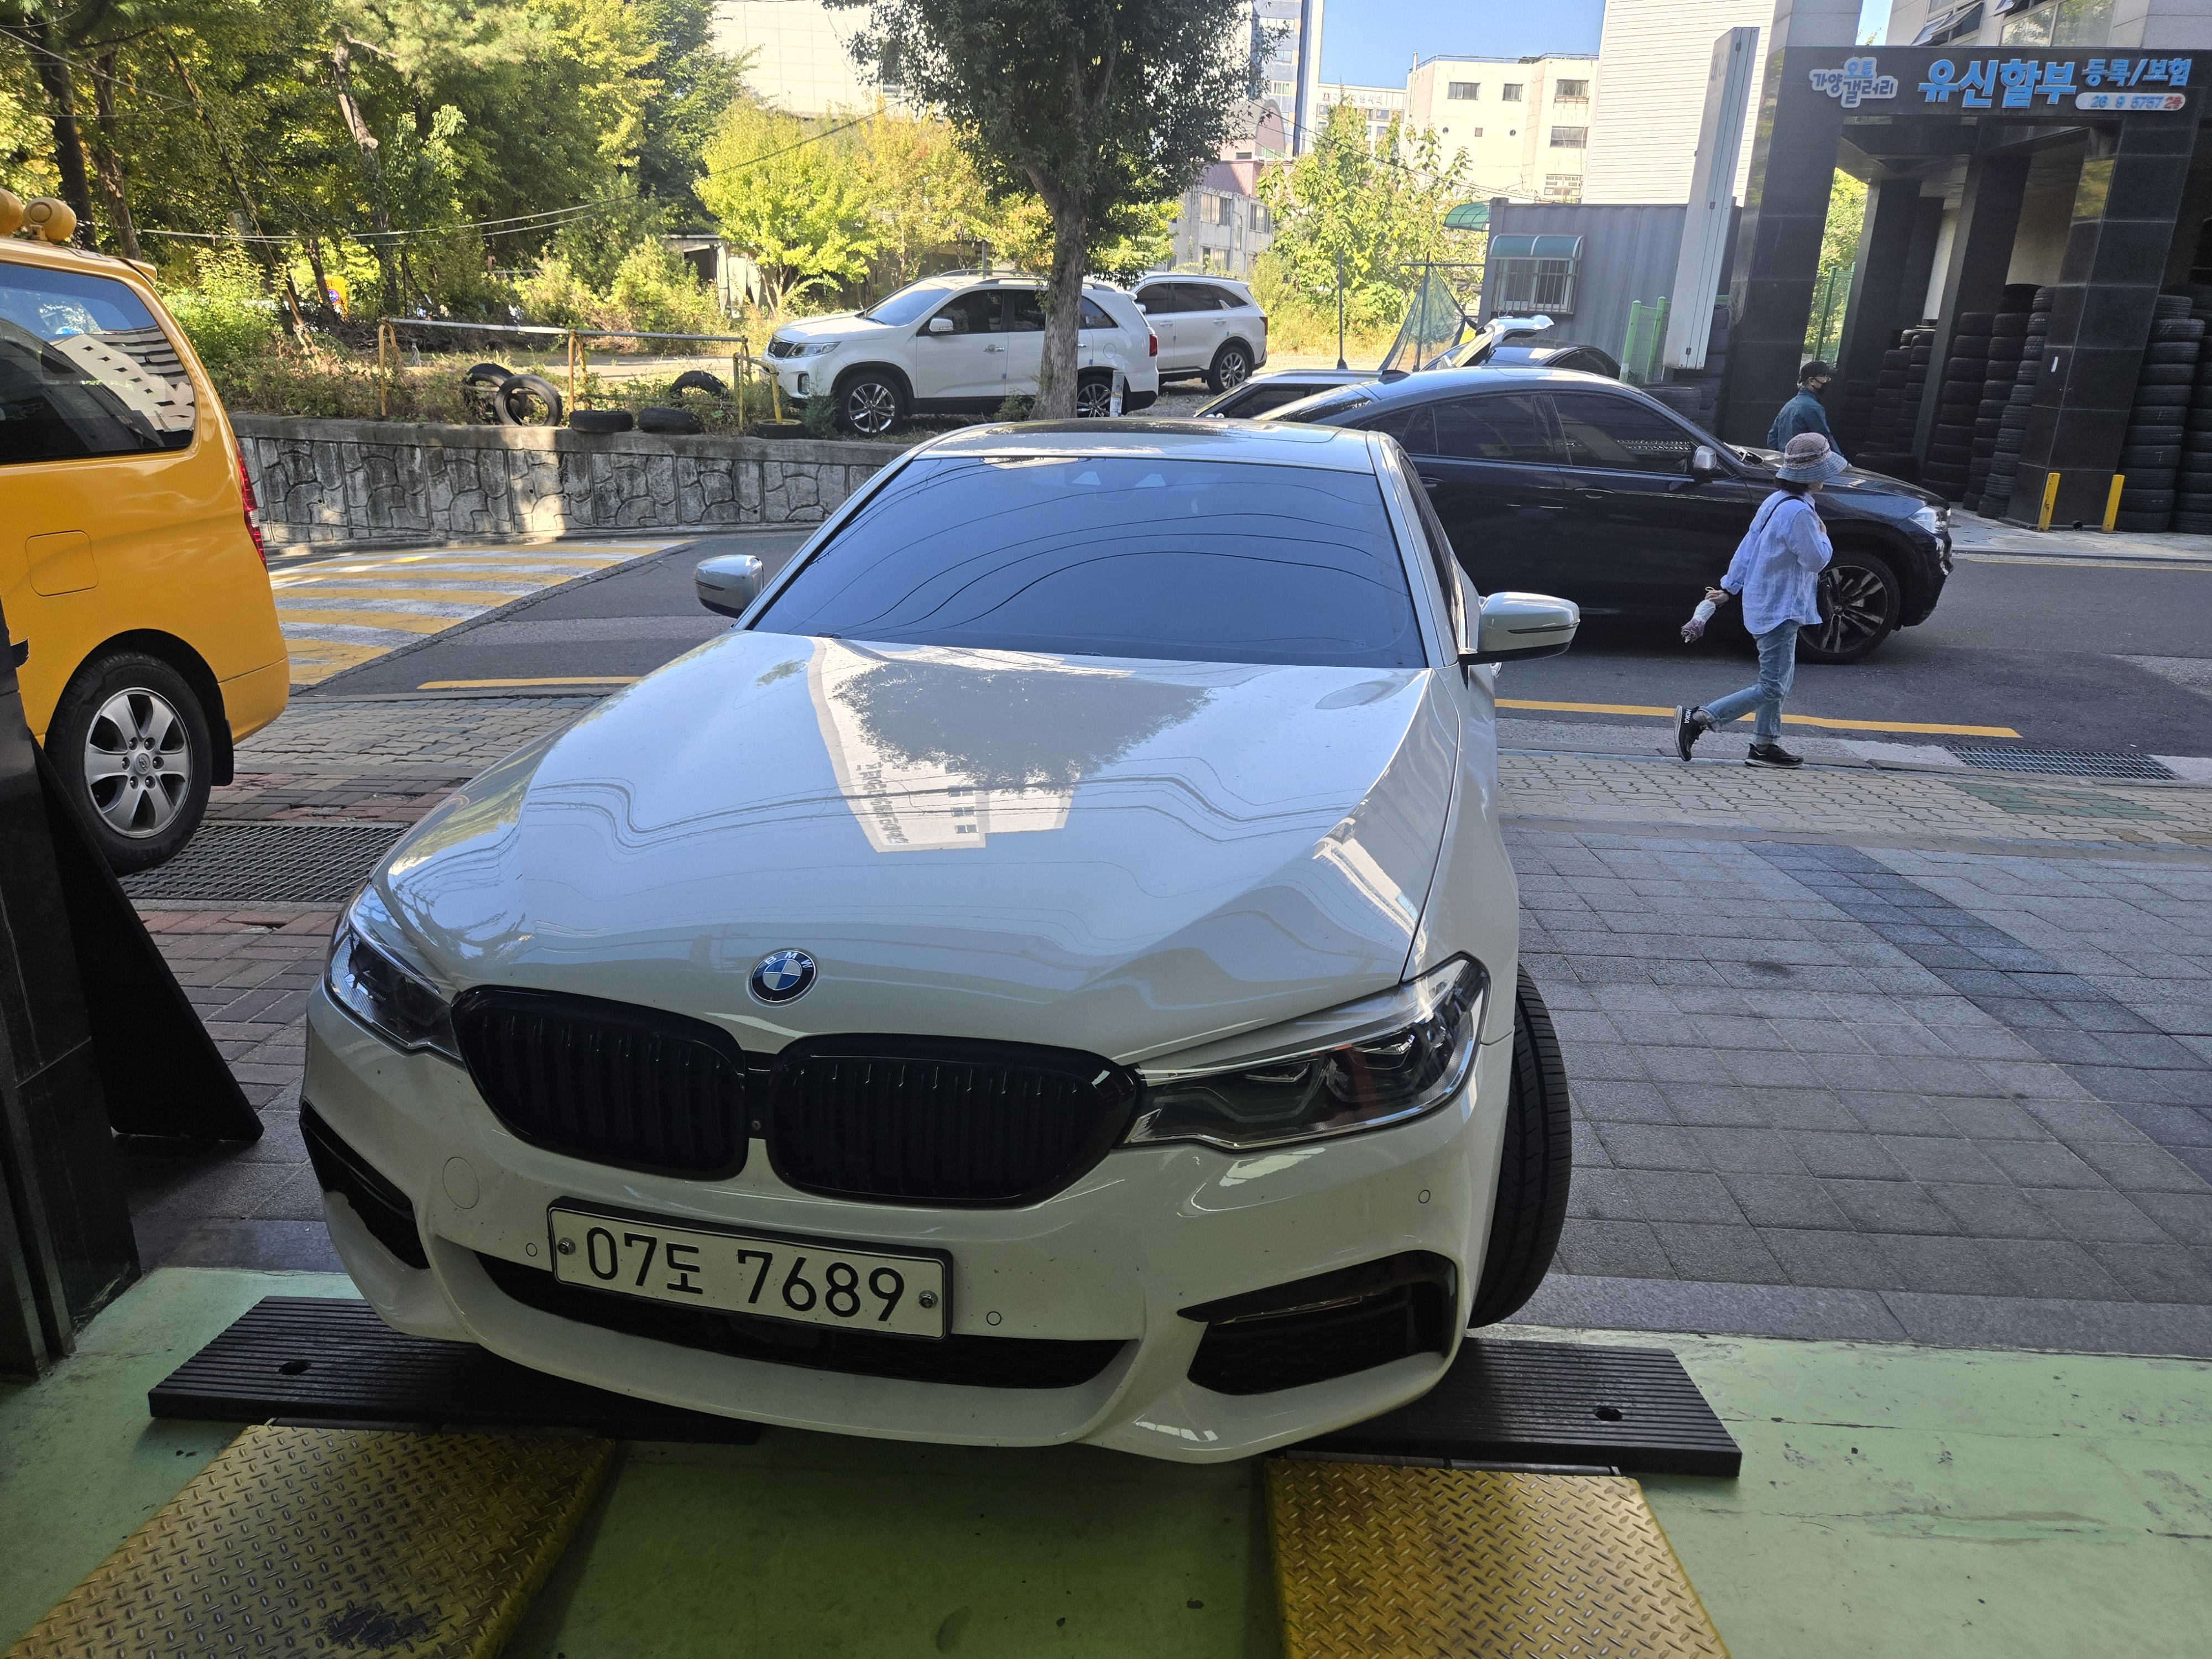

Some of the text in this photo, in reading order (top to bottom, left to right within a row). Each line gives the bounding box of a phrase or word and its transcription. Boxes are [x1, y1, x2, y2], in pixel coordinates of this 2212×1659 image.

[1813, 60, 1874, 93] 가양 오토
[1917, 58, 2077, 108] 유신할부
[2081, 58, 2193, 87] 등록/보험
[1843, 79, 1894, 104] 갤러리
[2131, 95, 2164, 109] 5757
[1683, 708, 1692, 723] HOKA
[764, 952, 813, 968] BMW
[586, 1227, 905, 1322] 07도 7689
